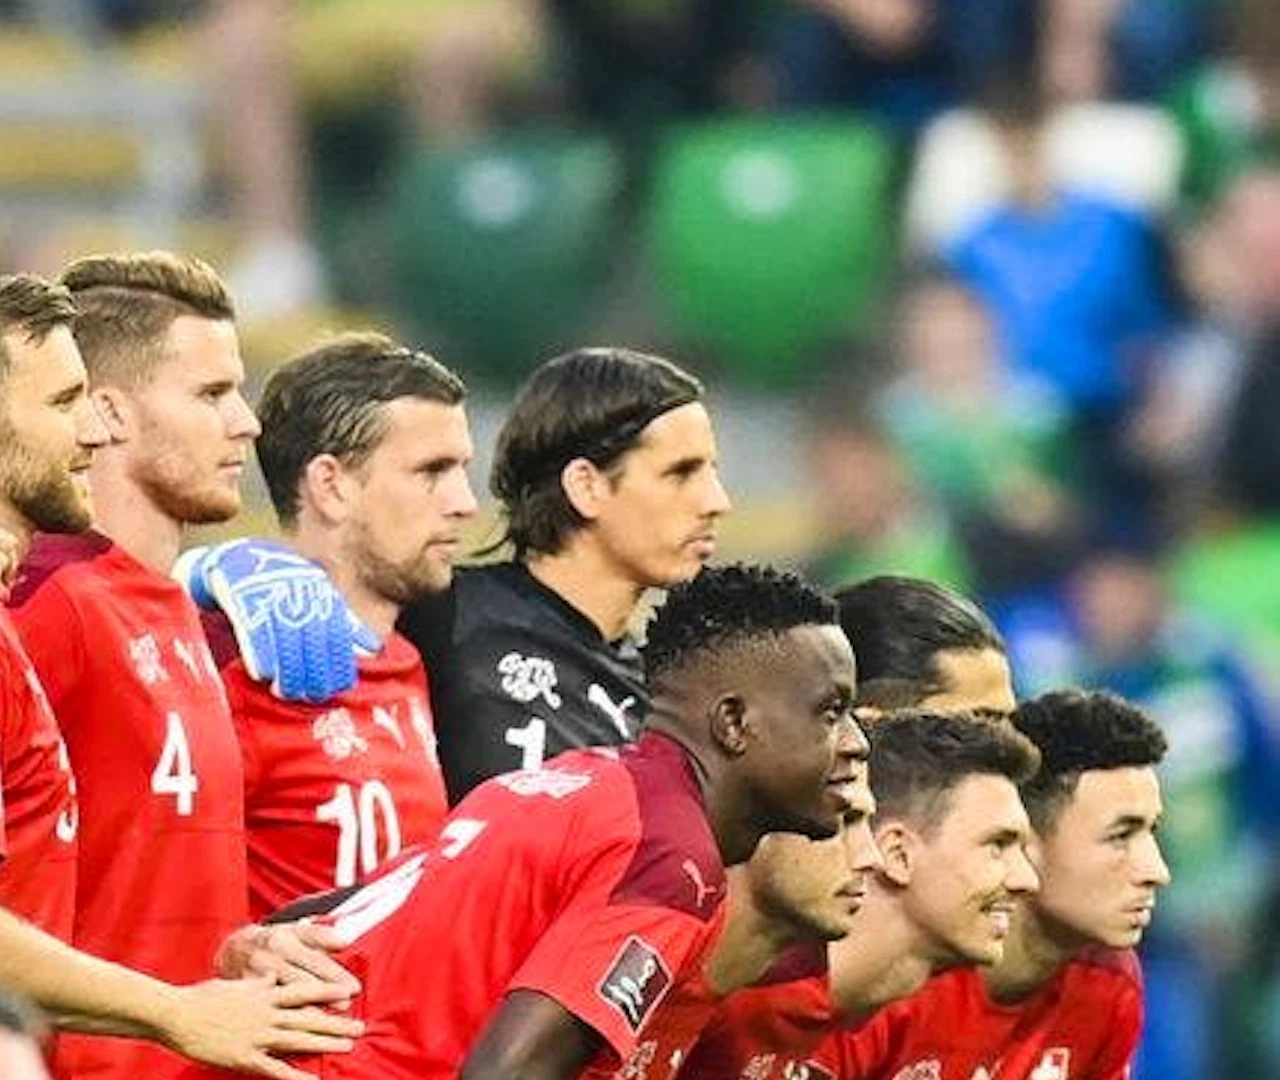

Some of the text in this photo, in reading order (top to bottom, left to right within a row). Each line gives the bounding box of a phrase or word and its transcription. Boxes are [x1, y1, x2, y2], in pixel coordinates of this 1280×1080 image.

[151, 711, 198, 816] 4
[505, 717, 546, 770] 1
[316, 780, 401, 888] 10
